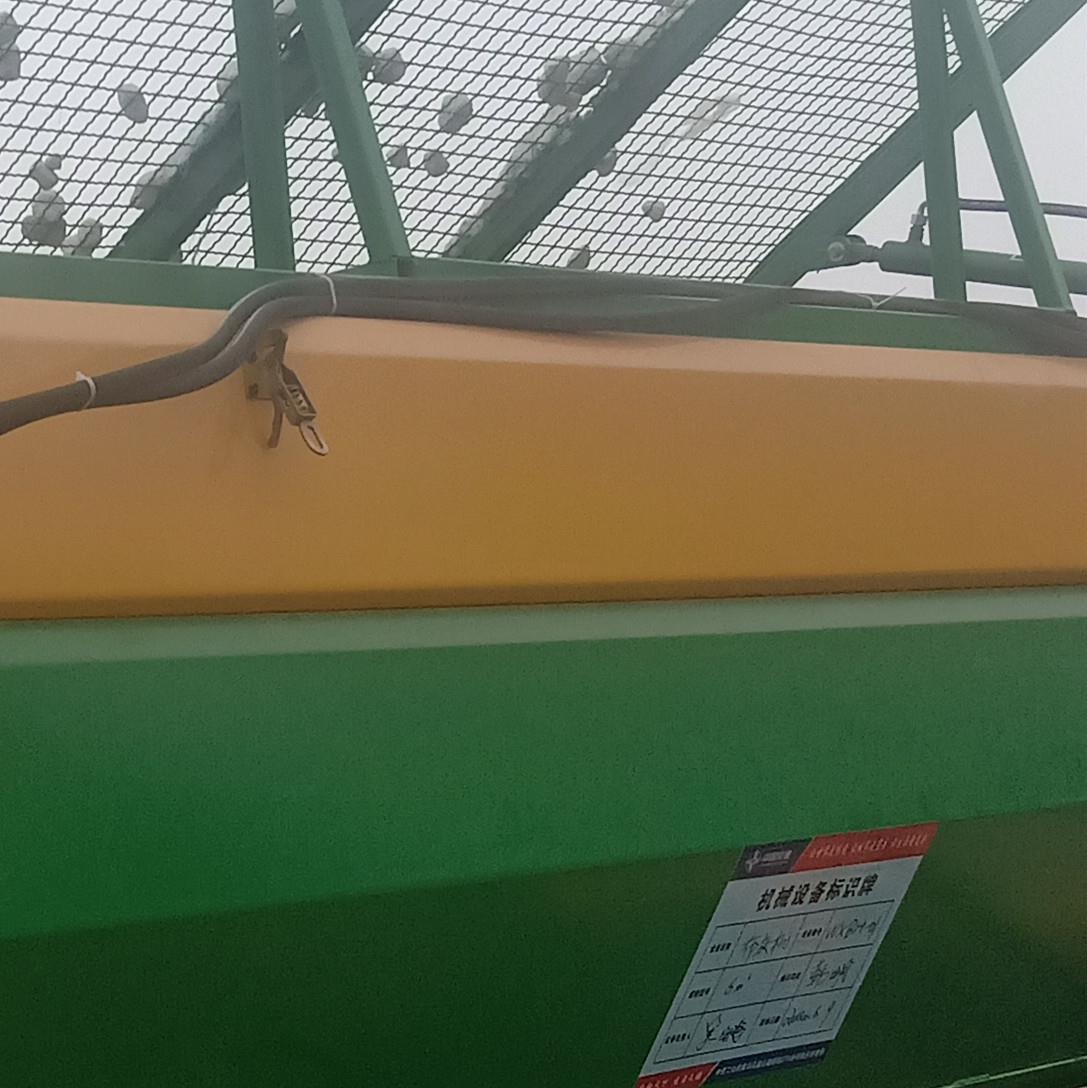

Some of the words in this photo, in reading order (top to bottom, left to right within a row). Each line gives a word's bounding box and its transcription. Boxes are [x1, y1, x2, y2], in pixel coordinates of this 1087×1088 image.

[756, 873, 879, 912] 机械设备标识牌
